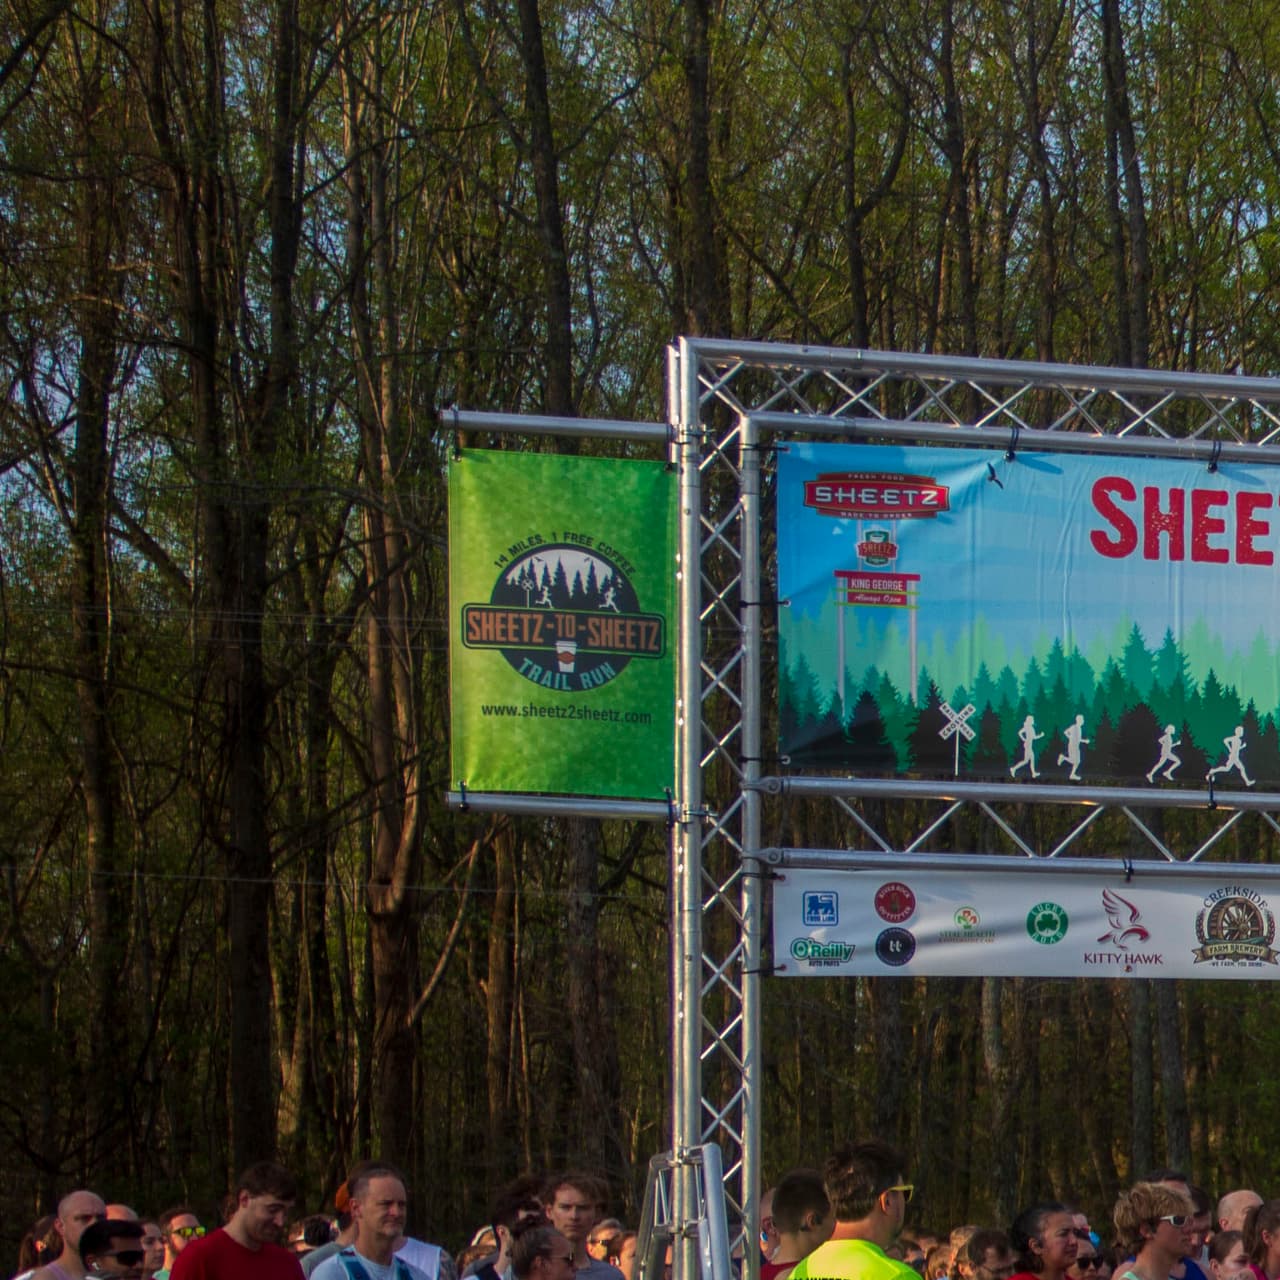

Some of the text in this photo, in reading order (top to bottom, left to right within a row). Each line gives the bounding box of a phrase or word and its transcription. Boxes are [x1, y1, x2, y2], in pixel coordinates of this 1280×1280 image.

[815, 486, 939, 506] SHEETZ
[494, 556, 508, 568] 14
[552, 532, 557, 542] 1
[563, 531, 595, 547] FREE
[598, 541, 636, 576] COFFEE
[850, 578, 904, 591] KING GEORGE
[467, 610, 660, 651] SHEETZ-TO-SHEETZ
[518, 656, 617, 691] TRAIL RUN
[481, 702, 652, 725] www.sheetz2sheetz.com
[1203, 886, 1269, 910] CREEKSIDE
[1031, 903, 1065, 916] LUCKY
[793, 940, 853, 960] O'Reilly
[1083, 953, 1164, 965] KITTY HAWK
[1209, 944, 1264, 954] FARM BREWERY
